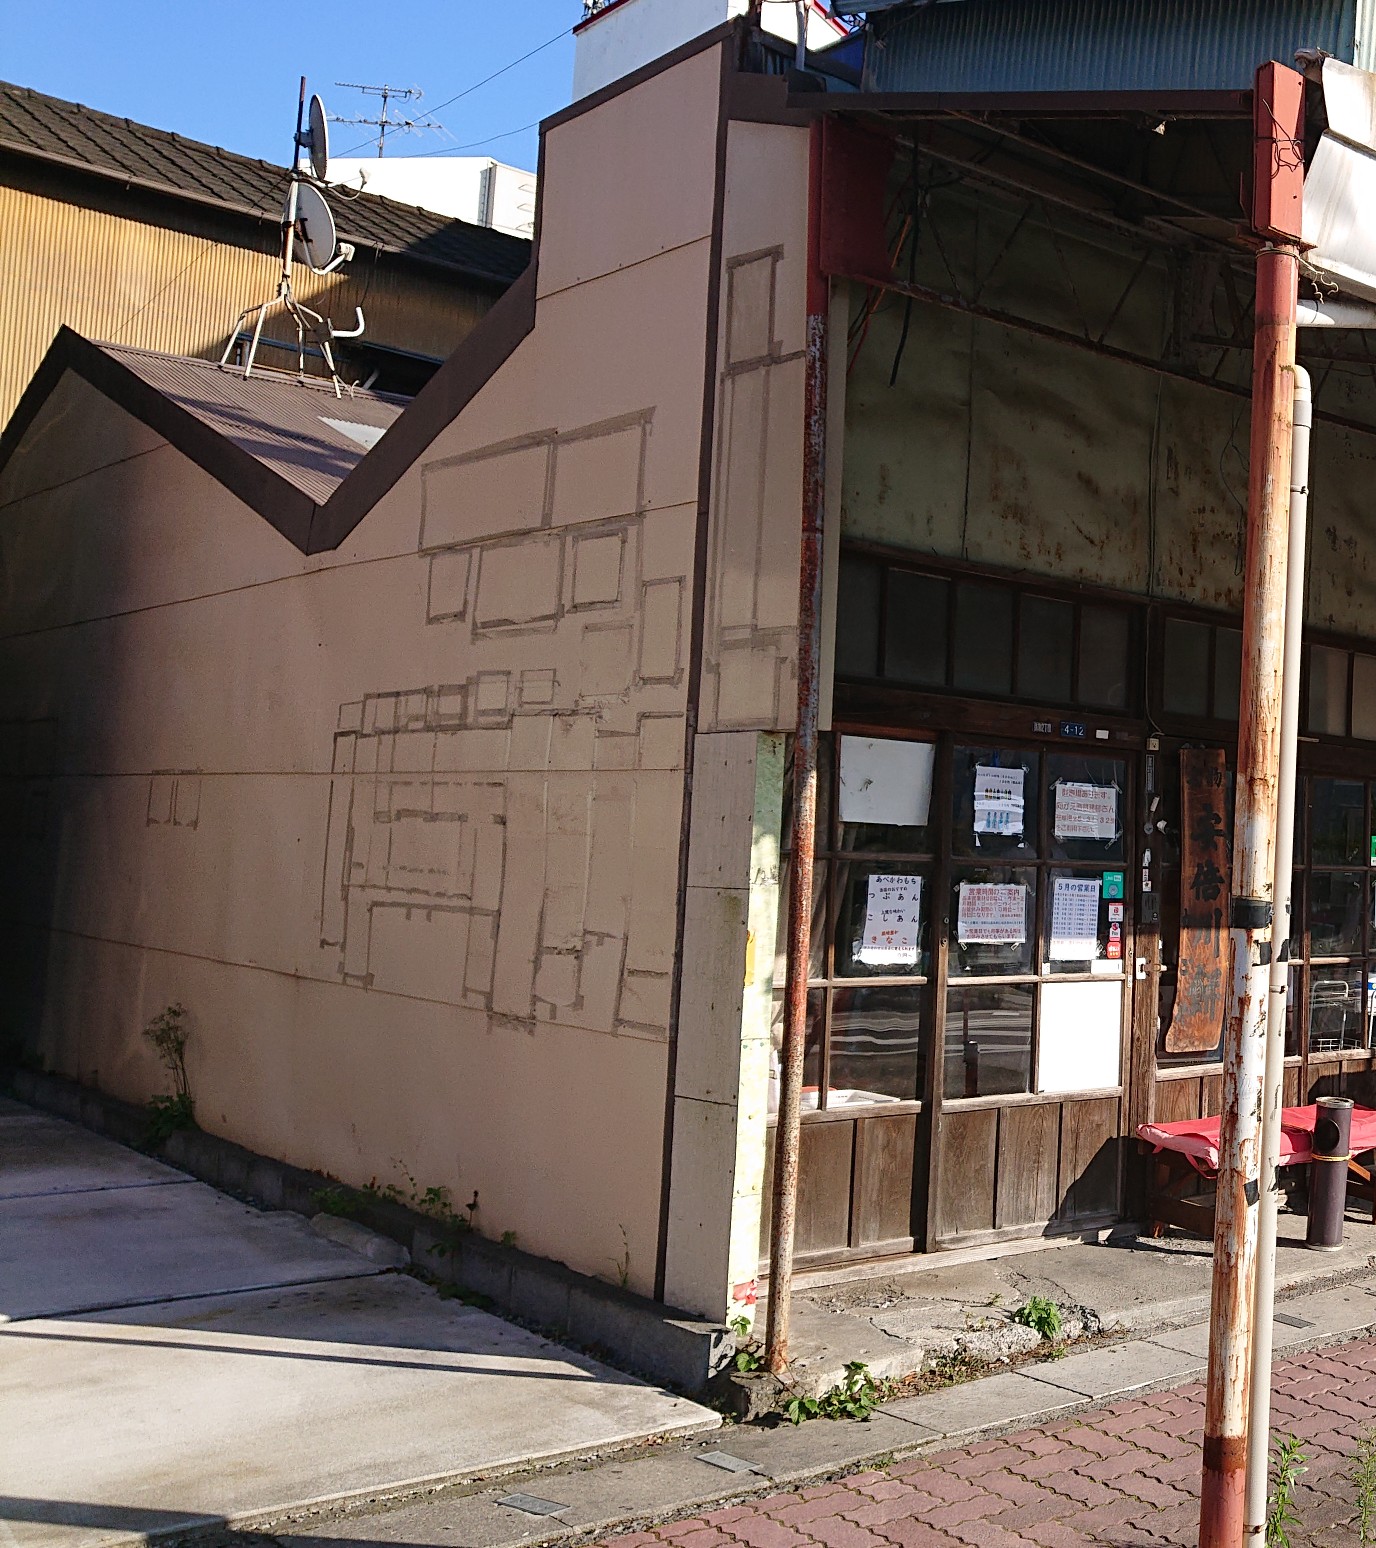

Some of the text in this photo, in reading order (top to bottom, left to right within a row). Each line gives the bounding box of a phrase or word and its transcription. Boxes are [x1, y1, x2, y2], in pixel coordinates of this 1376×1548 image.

[1064, 724, 1084, 736] 4-12
[875, 876, 917, 885] あべかわもち
[1058, 883, 1096, 893] 5月の営業日
